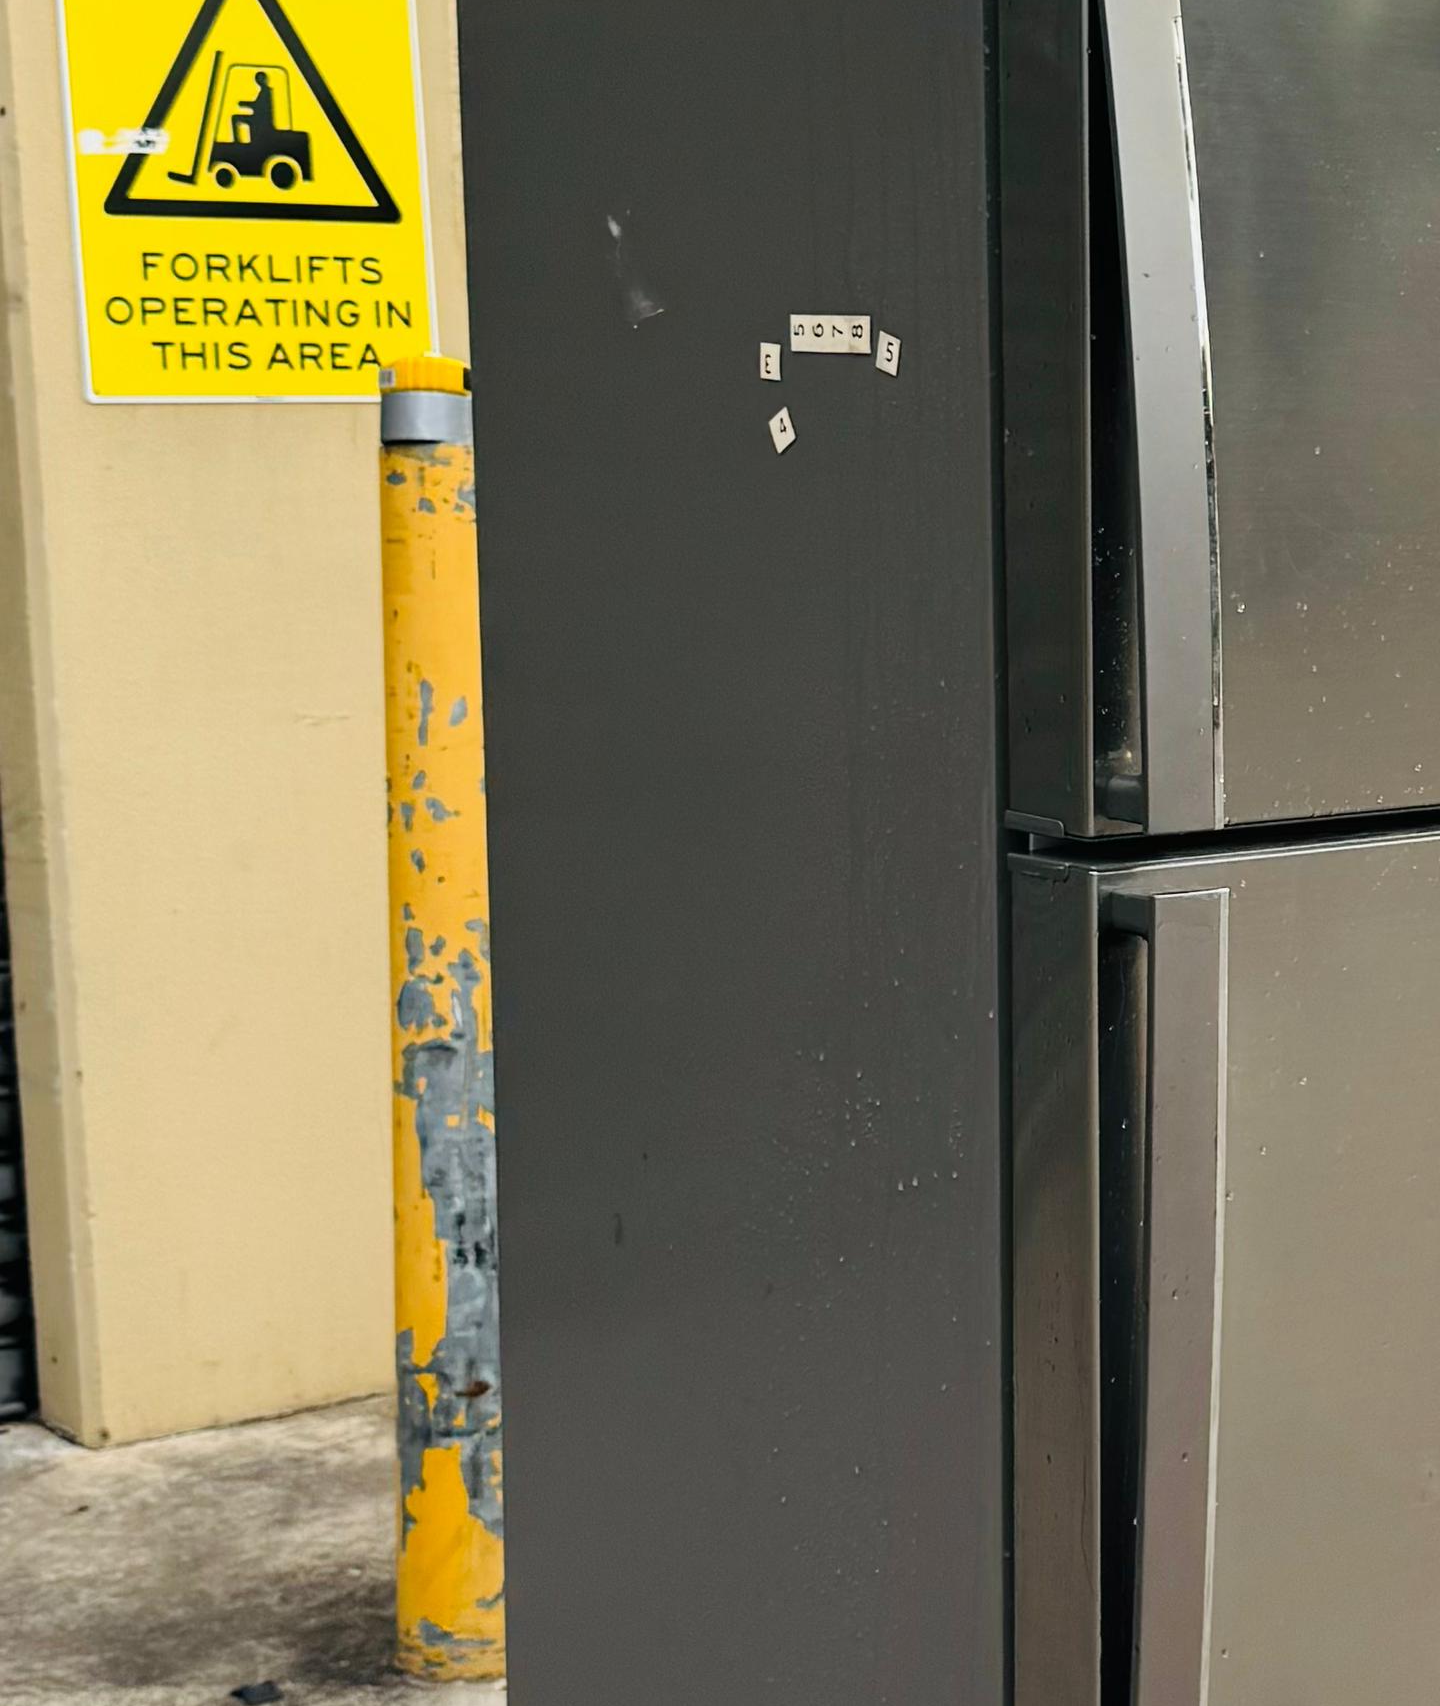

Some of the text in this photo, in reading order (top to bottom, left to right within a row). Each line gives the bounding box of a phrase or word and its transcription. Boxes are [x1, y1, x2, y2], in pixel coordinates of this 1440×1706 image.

[141, 252, 383, 285] FORKLIFTS
[105, 296, 412, 328] OPERATING IN
[151, 341, 383, 371] THIS AREA
